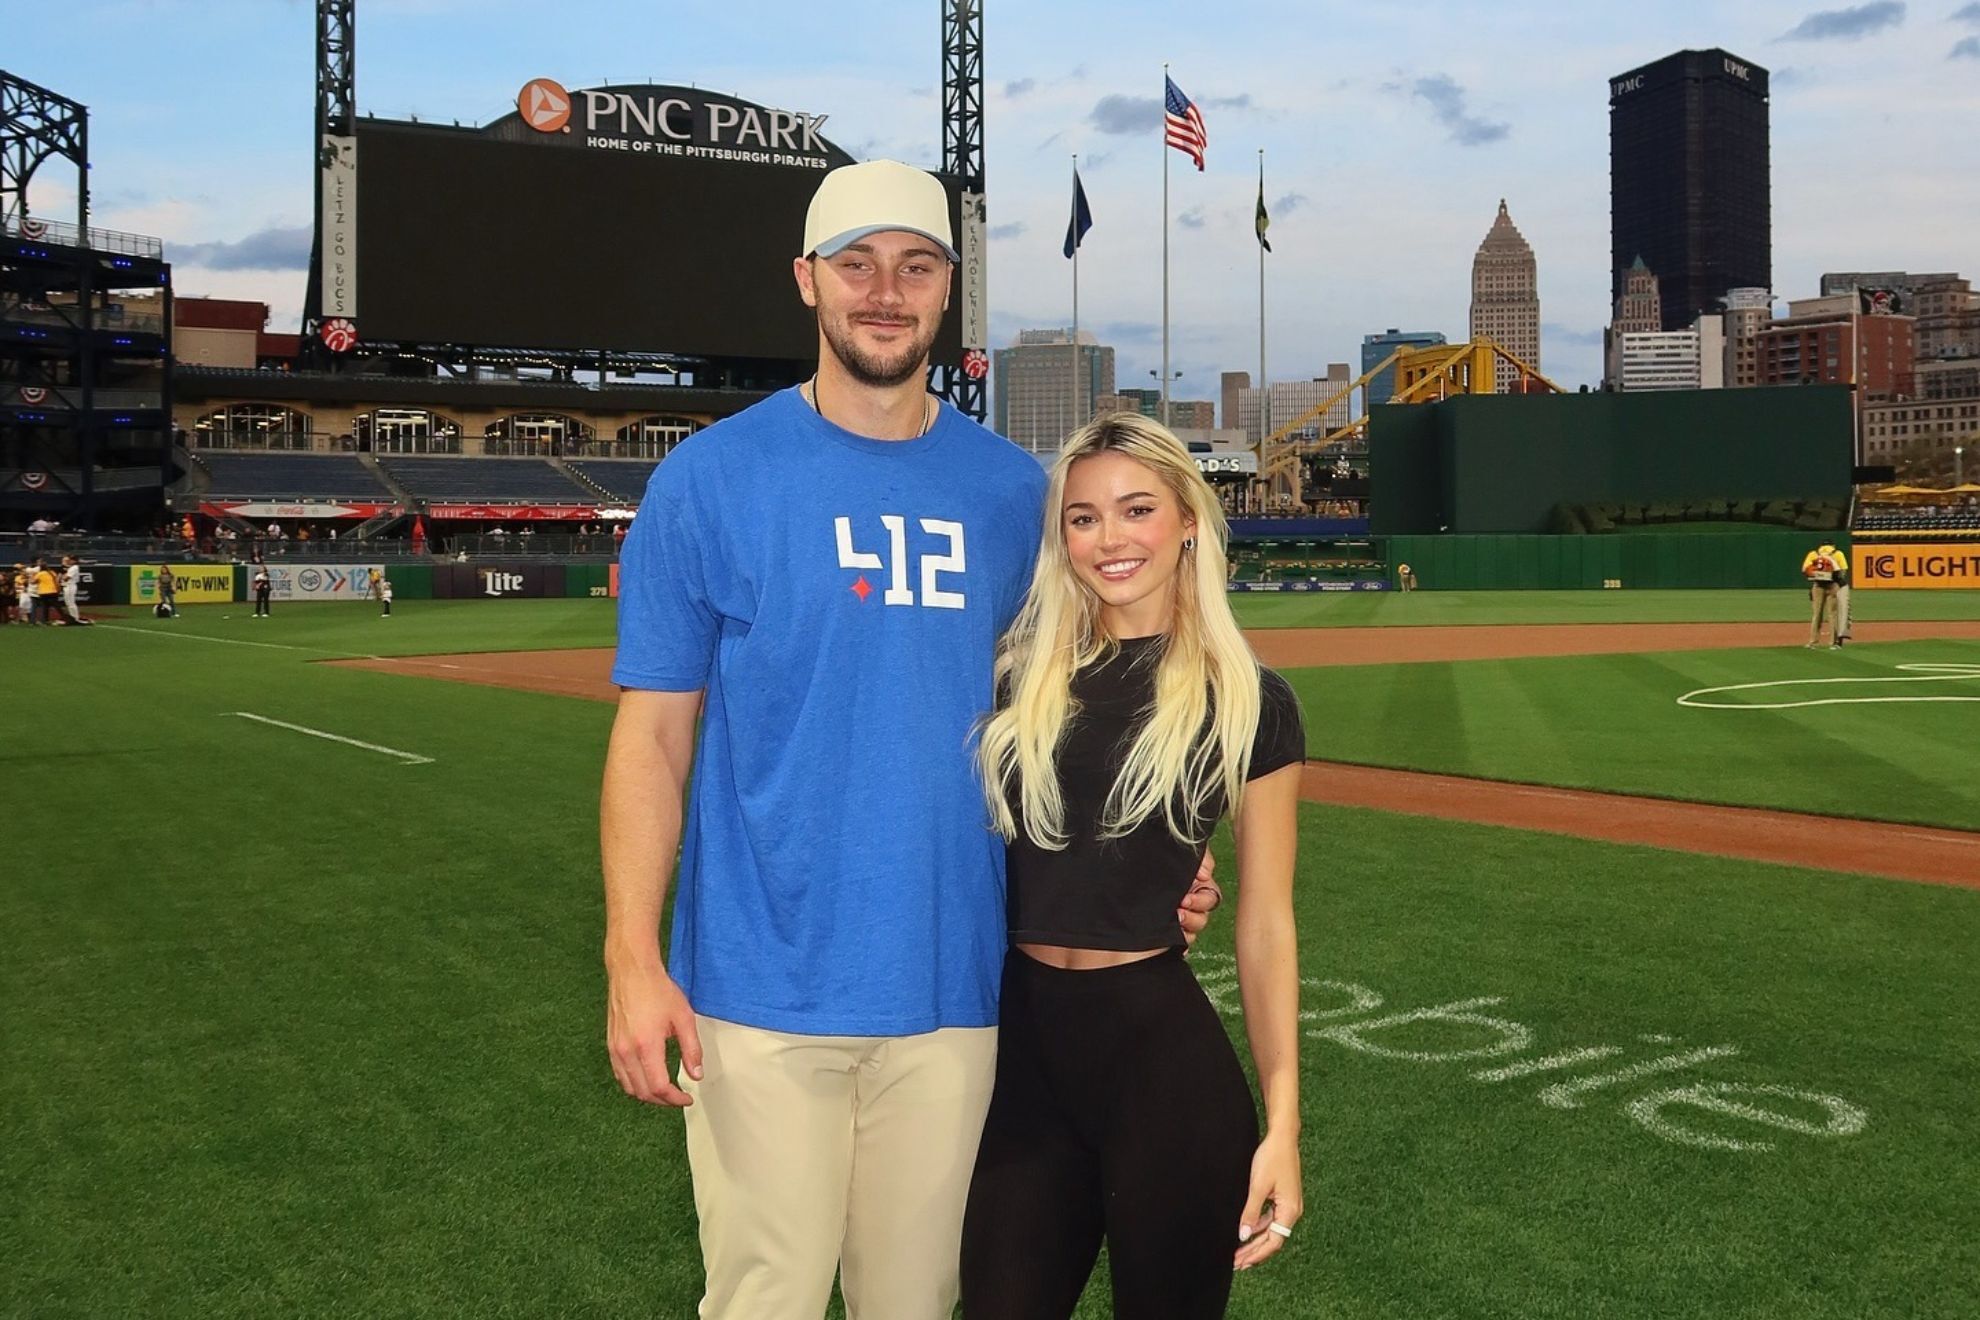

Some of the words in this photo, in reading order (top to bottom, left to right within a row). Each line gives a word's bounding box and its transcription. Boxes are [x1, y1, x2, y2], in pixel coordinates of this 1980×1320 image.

[1723, 57, 1750, 82] UPMC
[581, 89, 692, 140] PNC
[703, 102, 830, 153] PARK
[586, 135, 628, 151] HOME
[632, 140, 652, 152] OF
[655, 142, 683, 156] THE
[686, 146, 770, 164] PITTSBURGH
[773, 153, 827, 169] PIRATES
[335, 175, 346, 224] LETZ
[334, 232, 345, 256] GO
[968, 224, 979, 253] EAT
[334, 263, 345, 312] BUCS
[968, 288, 977, 345] CHIKIN
[1194, 458, 1240, 472] AD'S
[834, 515, 966, 609] 412
[1902, 556, 1980, 577] LIGHT
[191, 579, 201, 589] TO
[202, 576, 229, 591] WIN!
[484, 571, 524, 596] Lite
